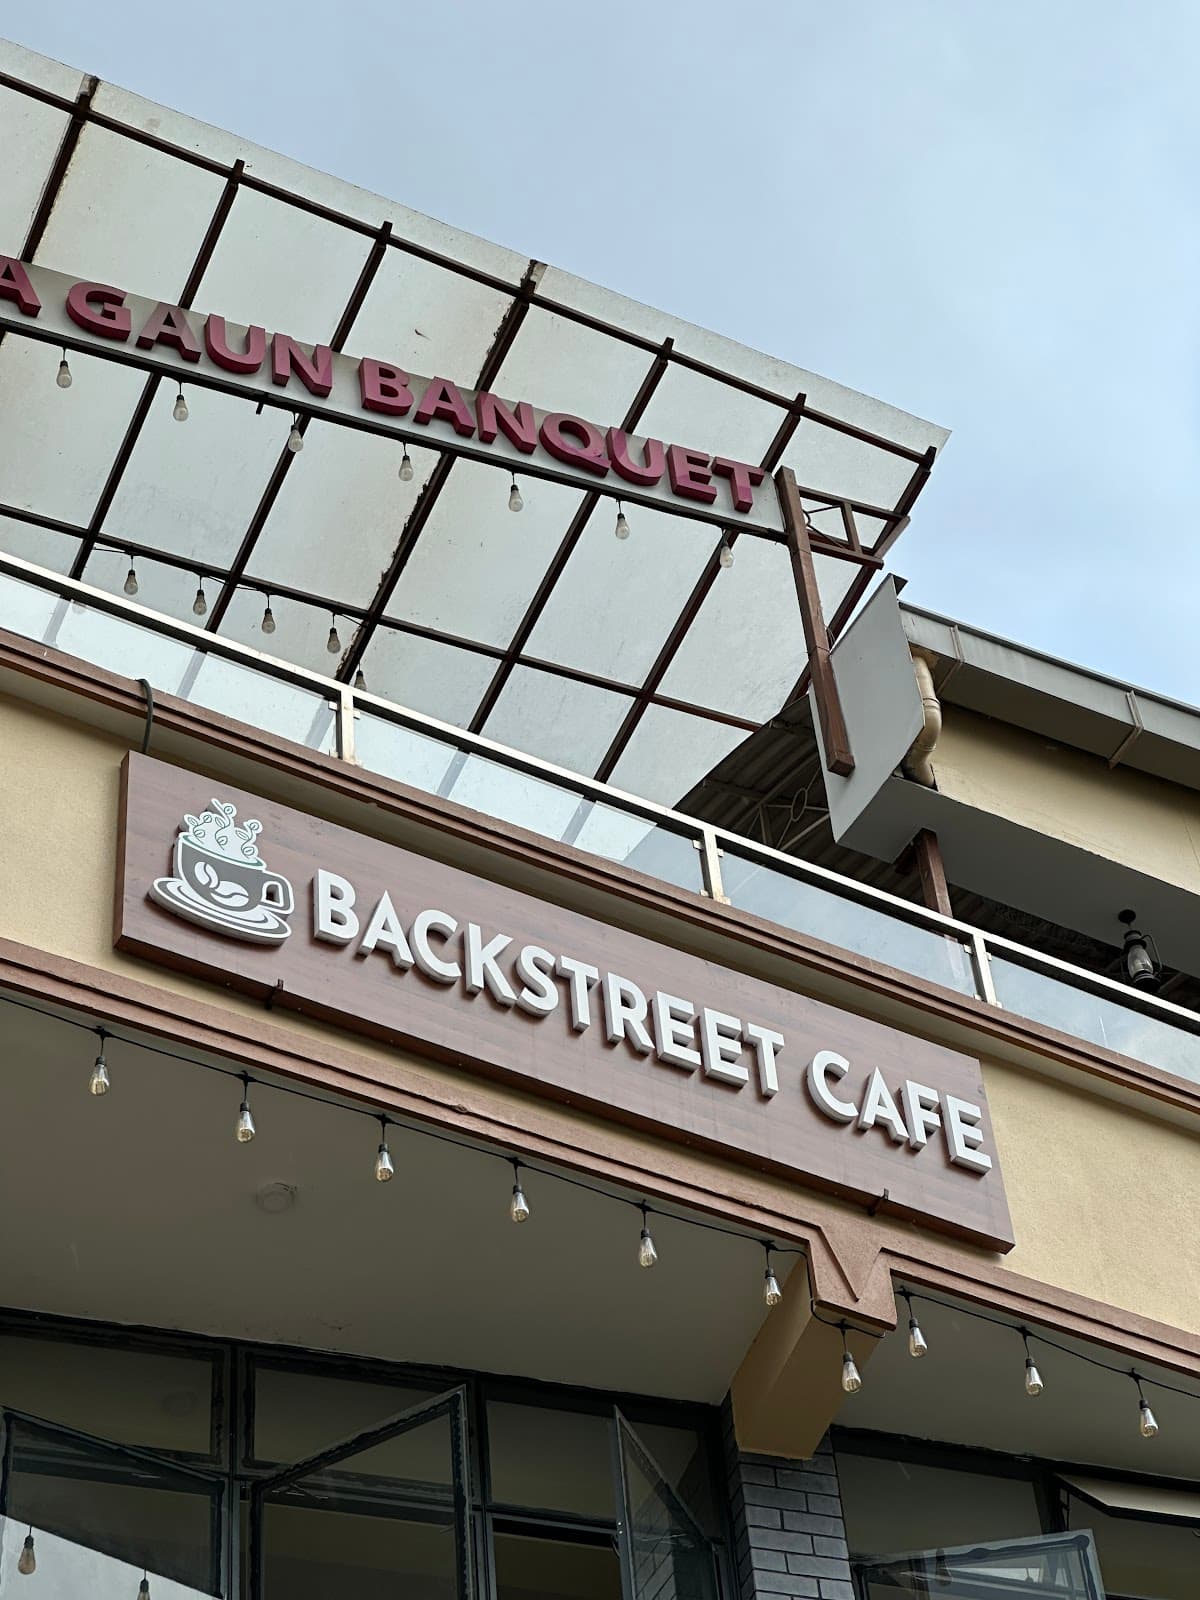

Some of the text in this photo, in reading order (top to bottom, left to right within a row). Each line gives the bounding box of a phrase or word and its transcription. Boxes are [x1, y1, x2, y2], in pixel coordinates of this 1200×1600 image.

[0, 255, 765, 514] A GAUN BANQUET
[312, 868, 993, 1175] BACKSTREET CAFE
